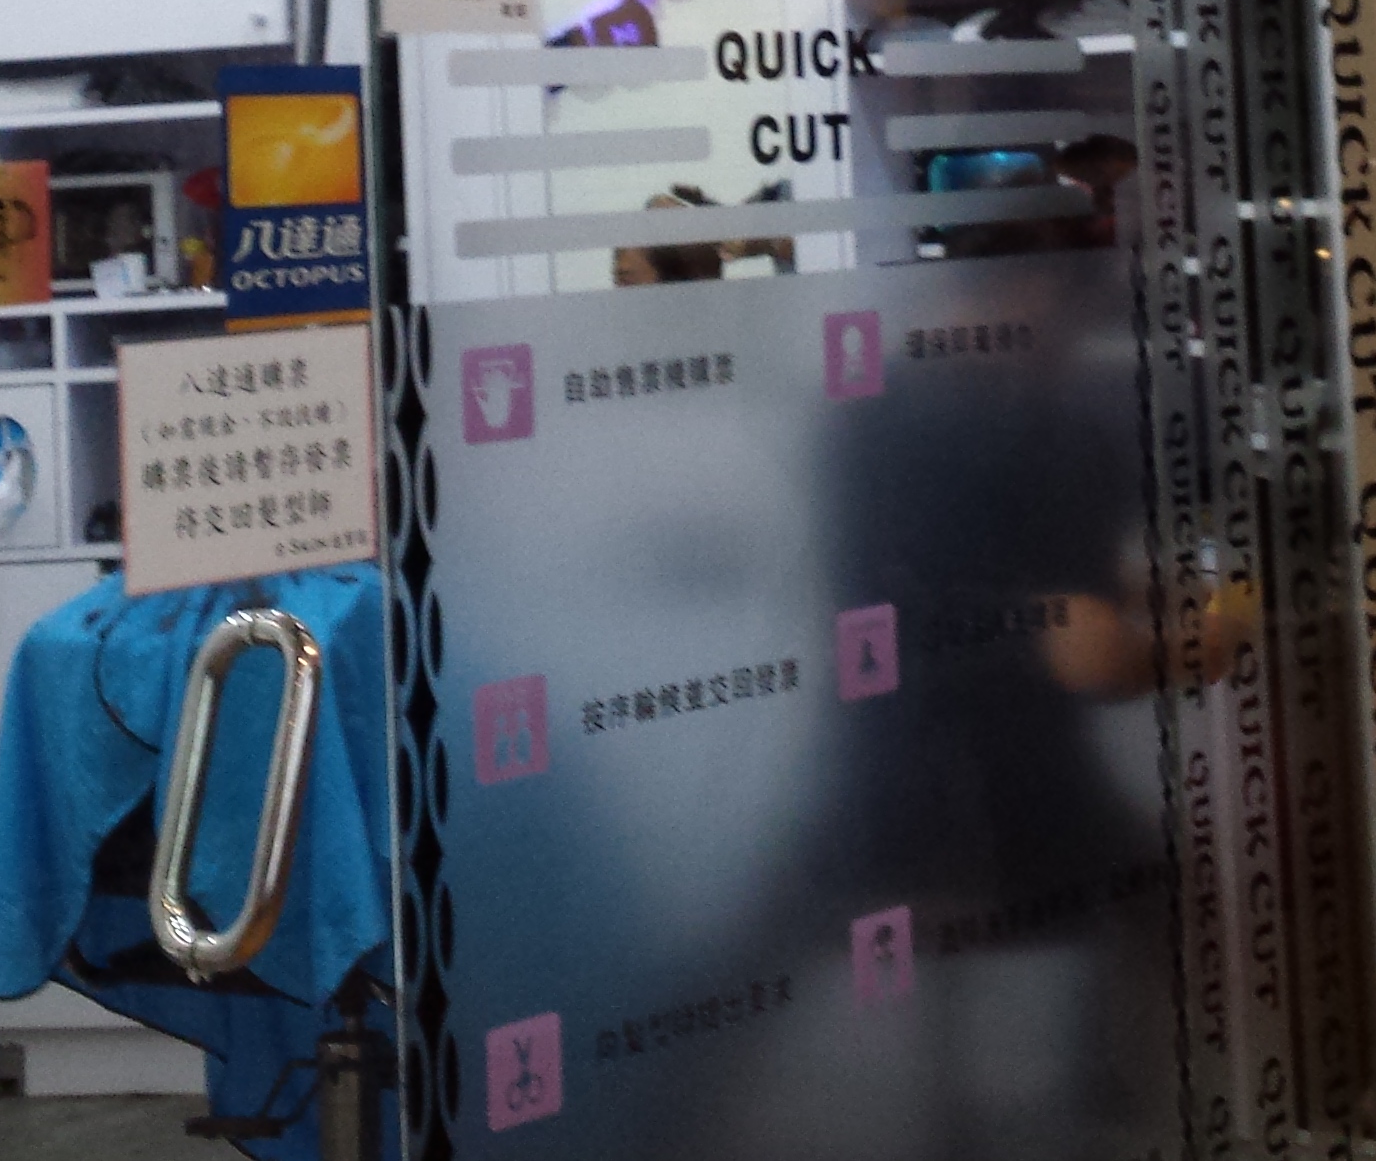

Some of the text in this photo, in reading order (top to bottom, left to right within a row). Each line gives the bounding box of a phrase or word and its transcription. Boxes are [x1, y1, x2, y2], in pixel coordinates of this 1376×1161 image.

[716, 28, 883, 83] QUICK
[748, 114, 853, 165] CUT
[1146, 80, 1179, 251] QUICK
[1199, 57, 1231, 196] CUT
[231, 263, 367, 293] OCTOPUS
[232, 215, 363, 264] 八達通
[1158, 261, 1188, 374] CUT
[1206, 235, 1246, 448] QUICK
[1163, 410, 1200, 587] QUICK
[1270, 315, 1321, 554] QUICK
[1222, 459, 1256, 599] CUT
[1286, 566, 1326, 720] CUT
[1228, 642, 1271, 857] QUICK
[1183, 750, 1219, 935] QUICK
[1196, 938, 1227, 1054] CUT
[1246, 869, 1282, 1012] CUT
